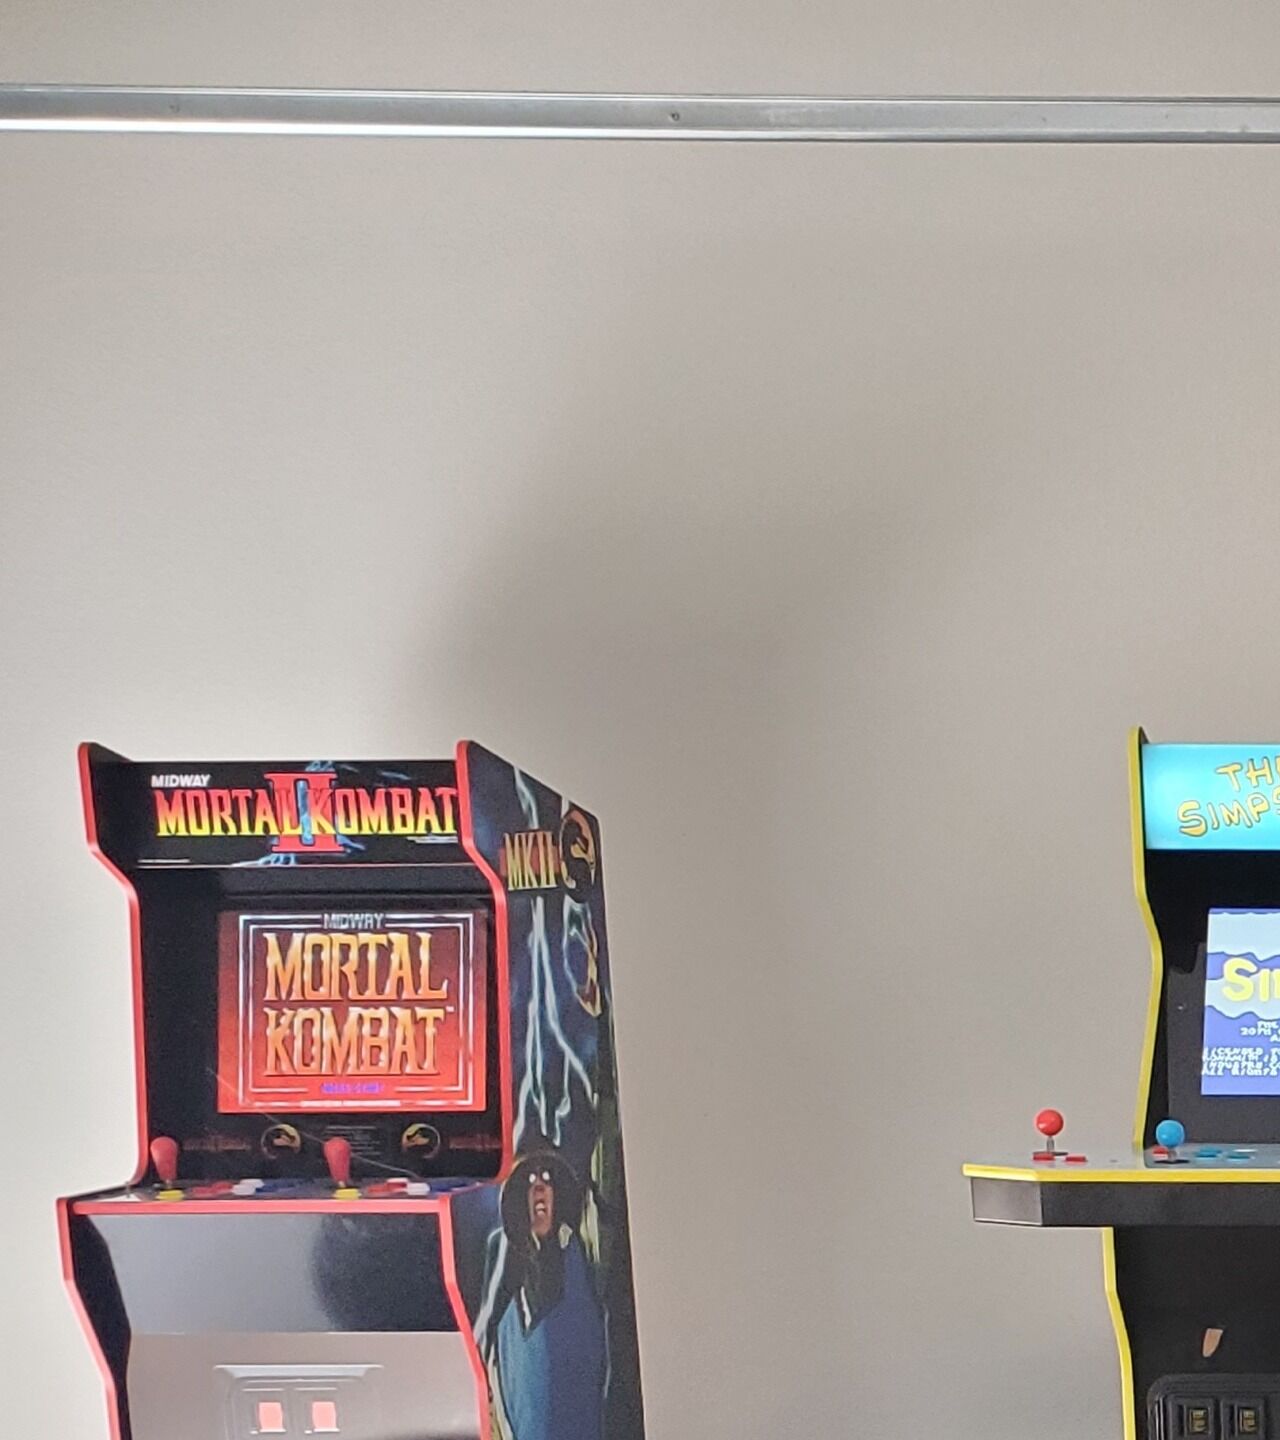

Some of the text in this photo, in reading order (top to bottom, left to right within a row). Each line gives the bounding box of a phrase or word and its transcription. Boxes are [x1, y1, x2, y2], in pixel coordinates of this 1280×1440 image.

[151, 774, 210, 788] MIDWAY
[156, 788, 306, 837] MORTAL
[305, 784, 458, 837] KOMBAT
[504, 831, 558, 891] MKII
[323, 913, 385, 929] MIDWAY
[263, 932, 450, 1001] MORTAL
[263, 1006, 445, 1076] KOMBAT
